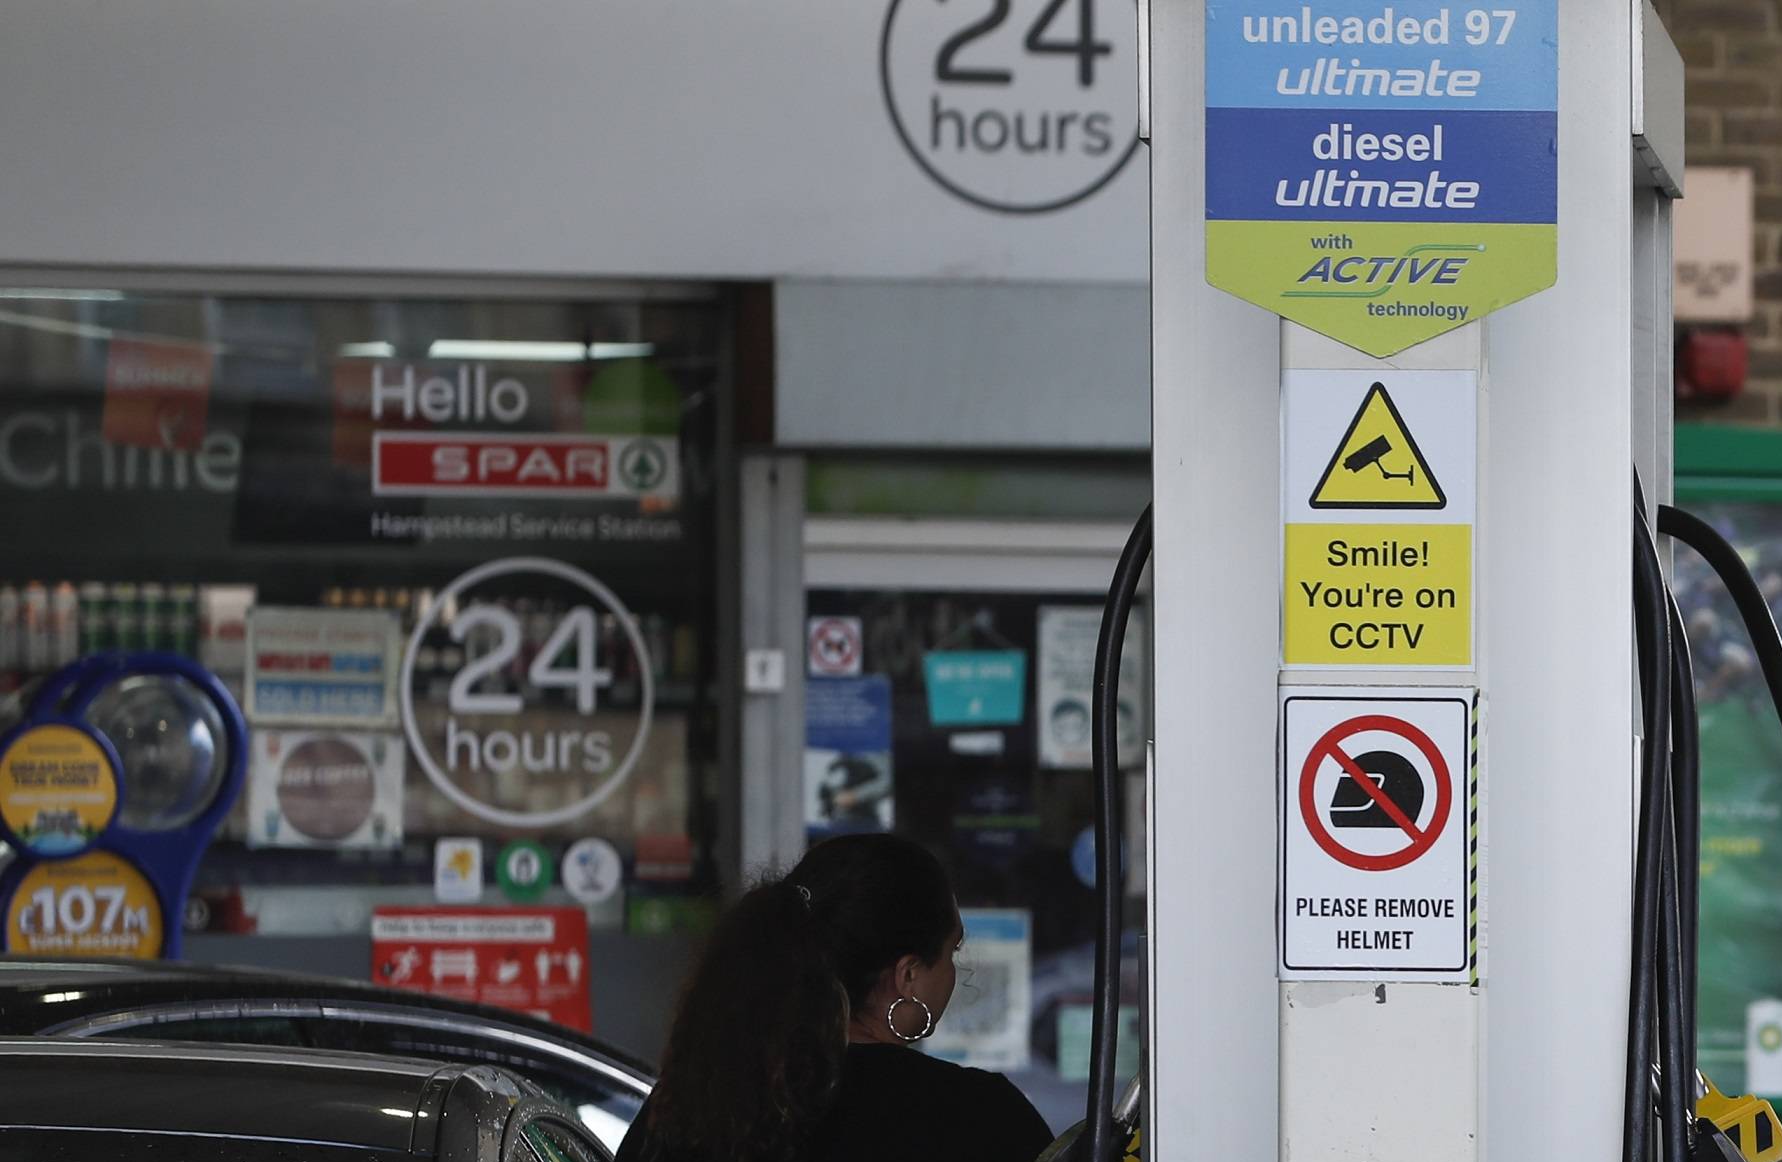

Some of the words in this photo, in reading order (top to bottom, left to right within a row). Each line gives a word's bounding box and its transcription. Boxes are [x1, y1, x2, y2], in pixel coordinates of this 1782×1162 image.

[935, 0, 1113, 87] 24
[1242, 6, 1449, 44] unleaded
[1465, 10, 1516, 45] 97
[1276, 58, 1481, 97] ultimate
[931, 95, 1112, 156] hours
[1312, 124, 1442, 161] diesel
[1275, 170, 1480, 208] ultimate
[1311, 234, 1353, 250] with
[1297, 257, 1468, 285] ACTIVE
[1367, 302, 1469, 321] technology
[372, 364, 528, 421] Hello
[432, 446, 605, 482] SPAR
[371, 512, 505, 542] Hampstead
[511, 512, 595, 538] Service
[1327, 541, 1429, 567] Smile!
[1301, 582, 1403, 608] You're
[1415, 589, 1456, 608] on
[1329, 624, 1424, 649] CCTV
[448, 604, 611, 715] 24
[447, 722, 611, 773] hours
[19, 884, 149, 937] £107M
[1296, 898, 1368, 918] PLEASE
[1375, 898, 1455, 919] REMOVE
[1336, 930, 1414, 950] HELMET
